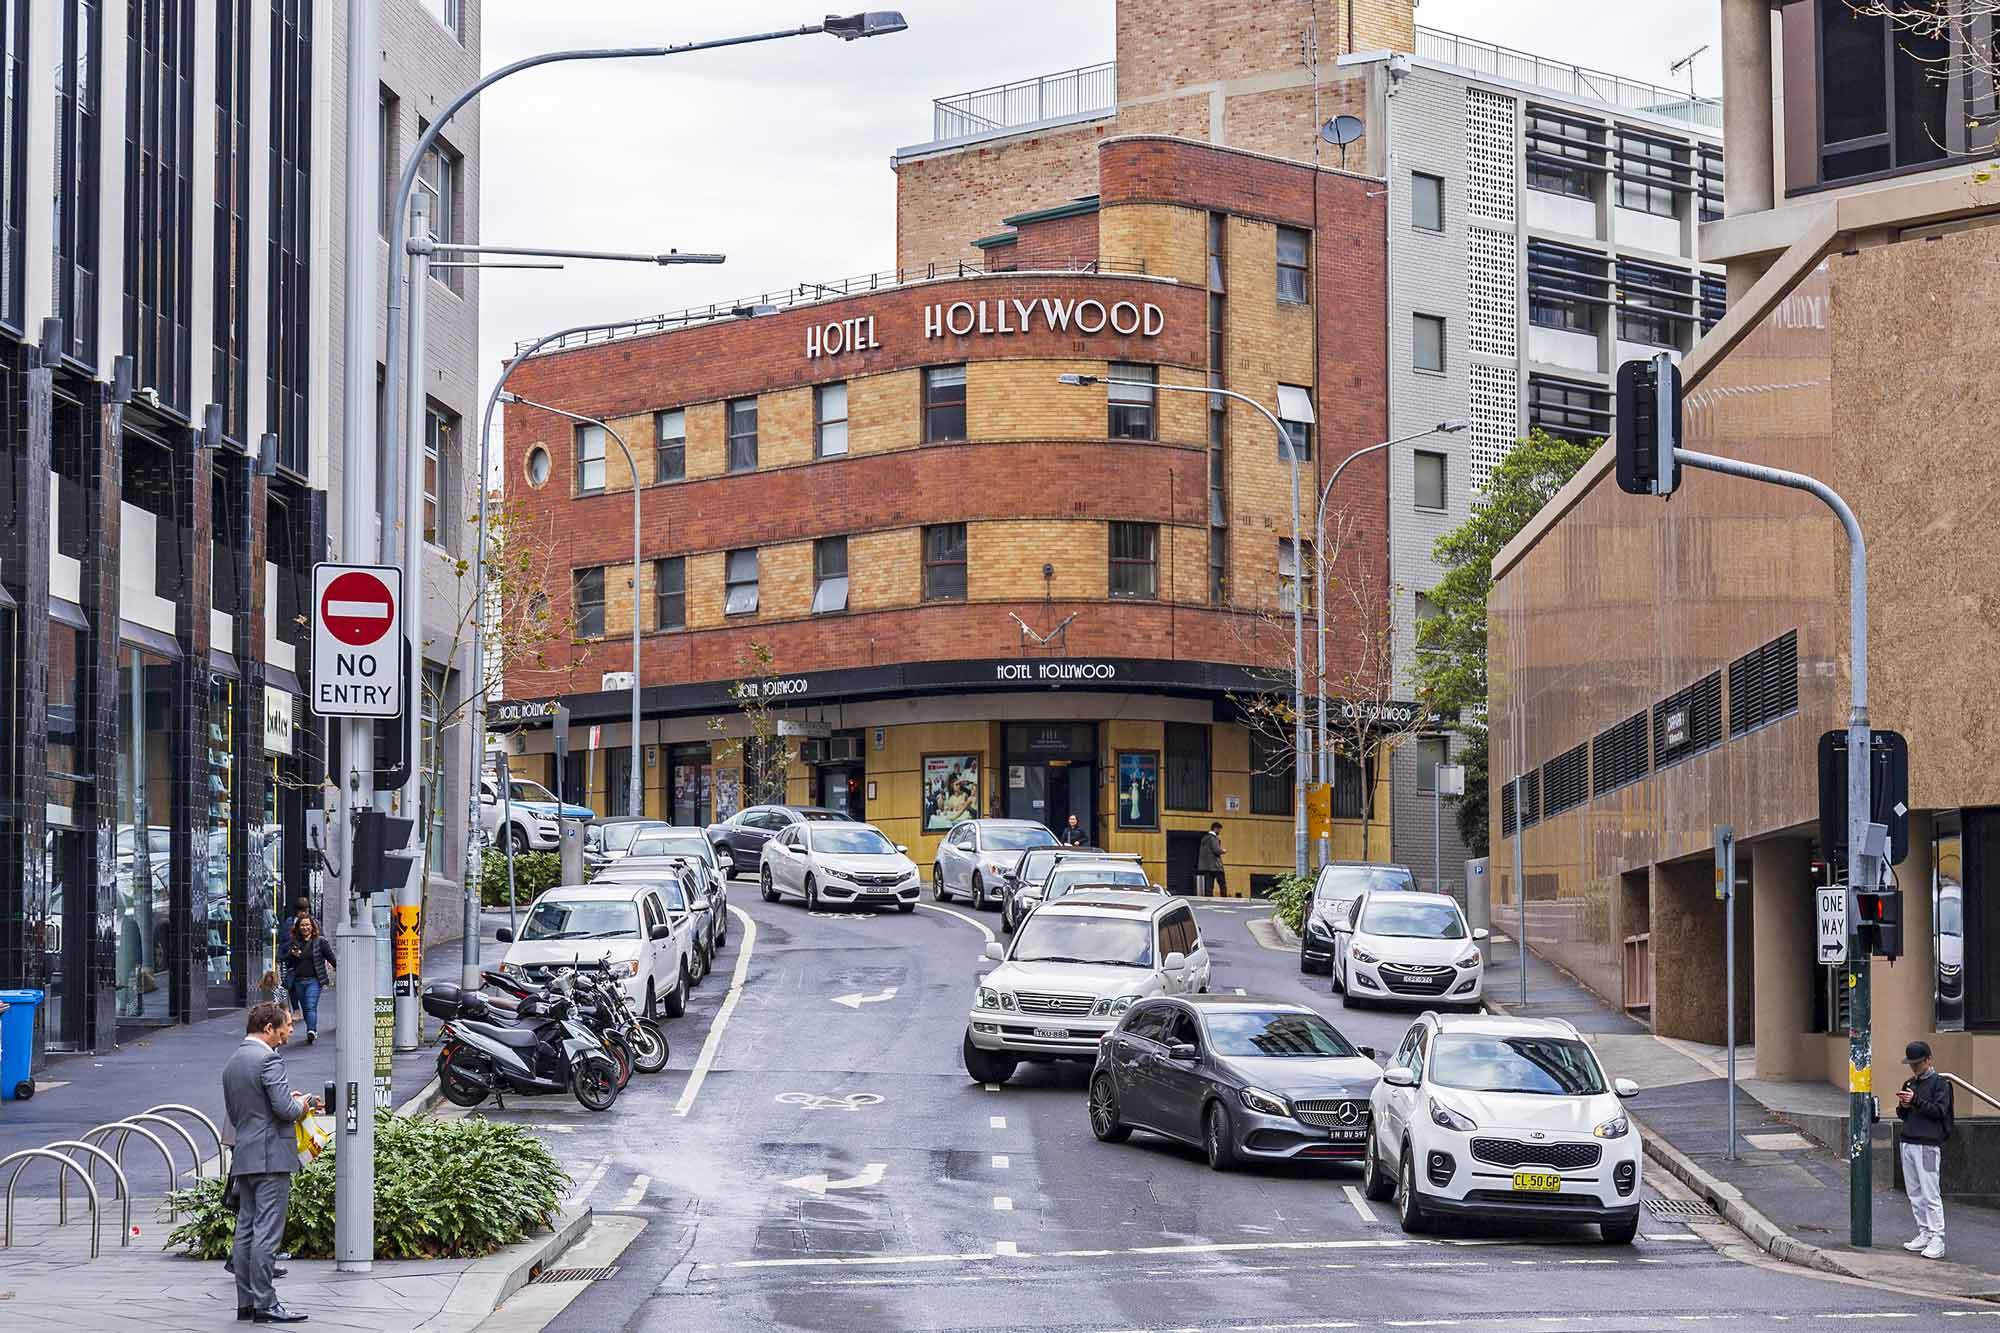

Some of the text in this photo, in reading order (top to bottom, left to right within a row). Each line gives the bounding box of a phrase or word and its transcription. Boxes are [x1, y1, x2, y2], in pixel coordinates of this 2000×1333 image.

[806, 298, 1164, 358] HOTEL HOLLYWOOD
[337, 653, 377, 677] NO
[997, 664, 1116, 679] HOTEL HOLLYWOOD
[320, 684, 392, 705] ENTRY
[1822, 895, 1843, 912] ONE
[1822, 919, 1844, 935] WAY
